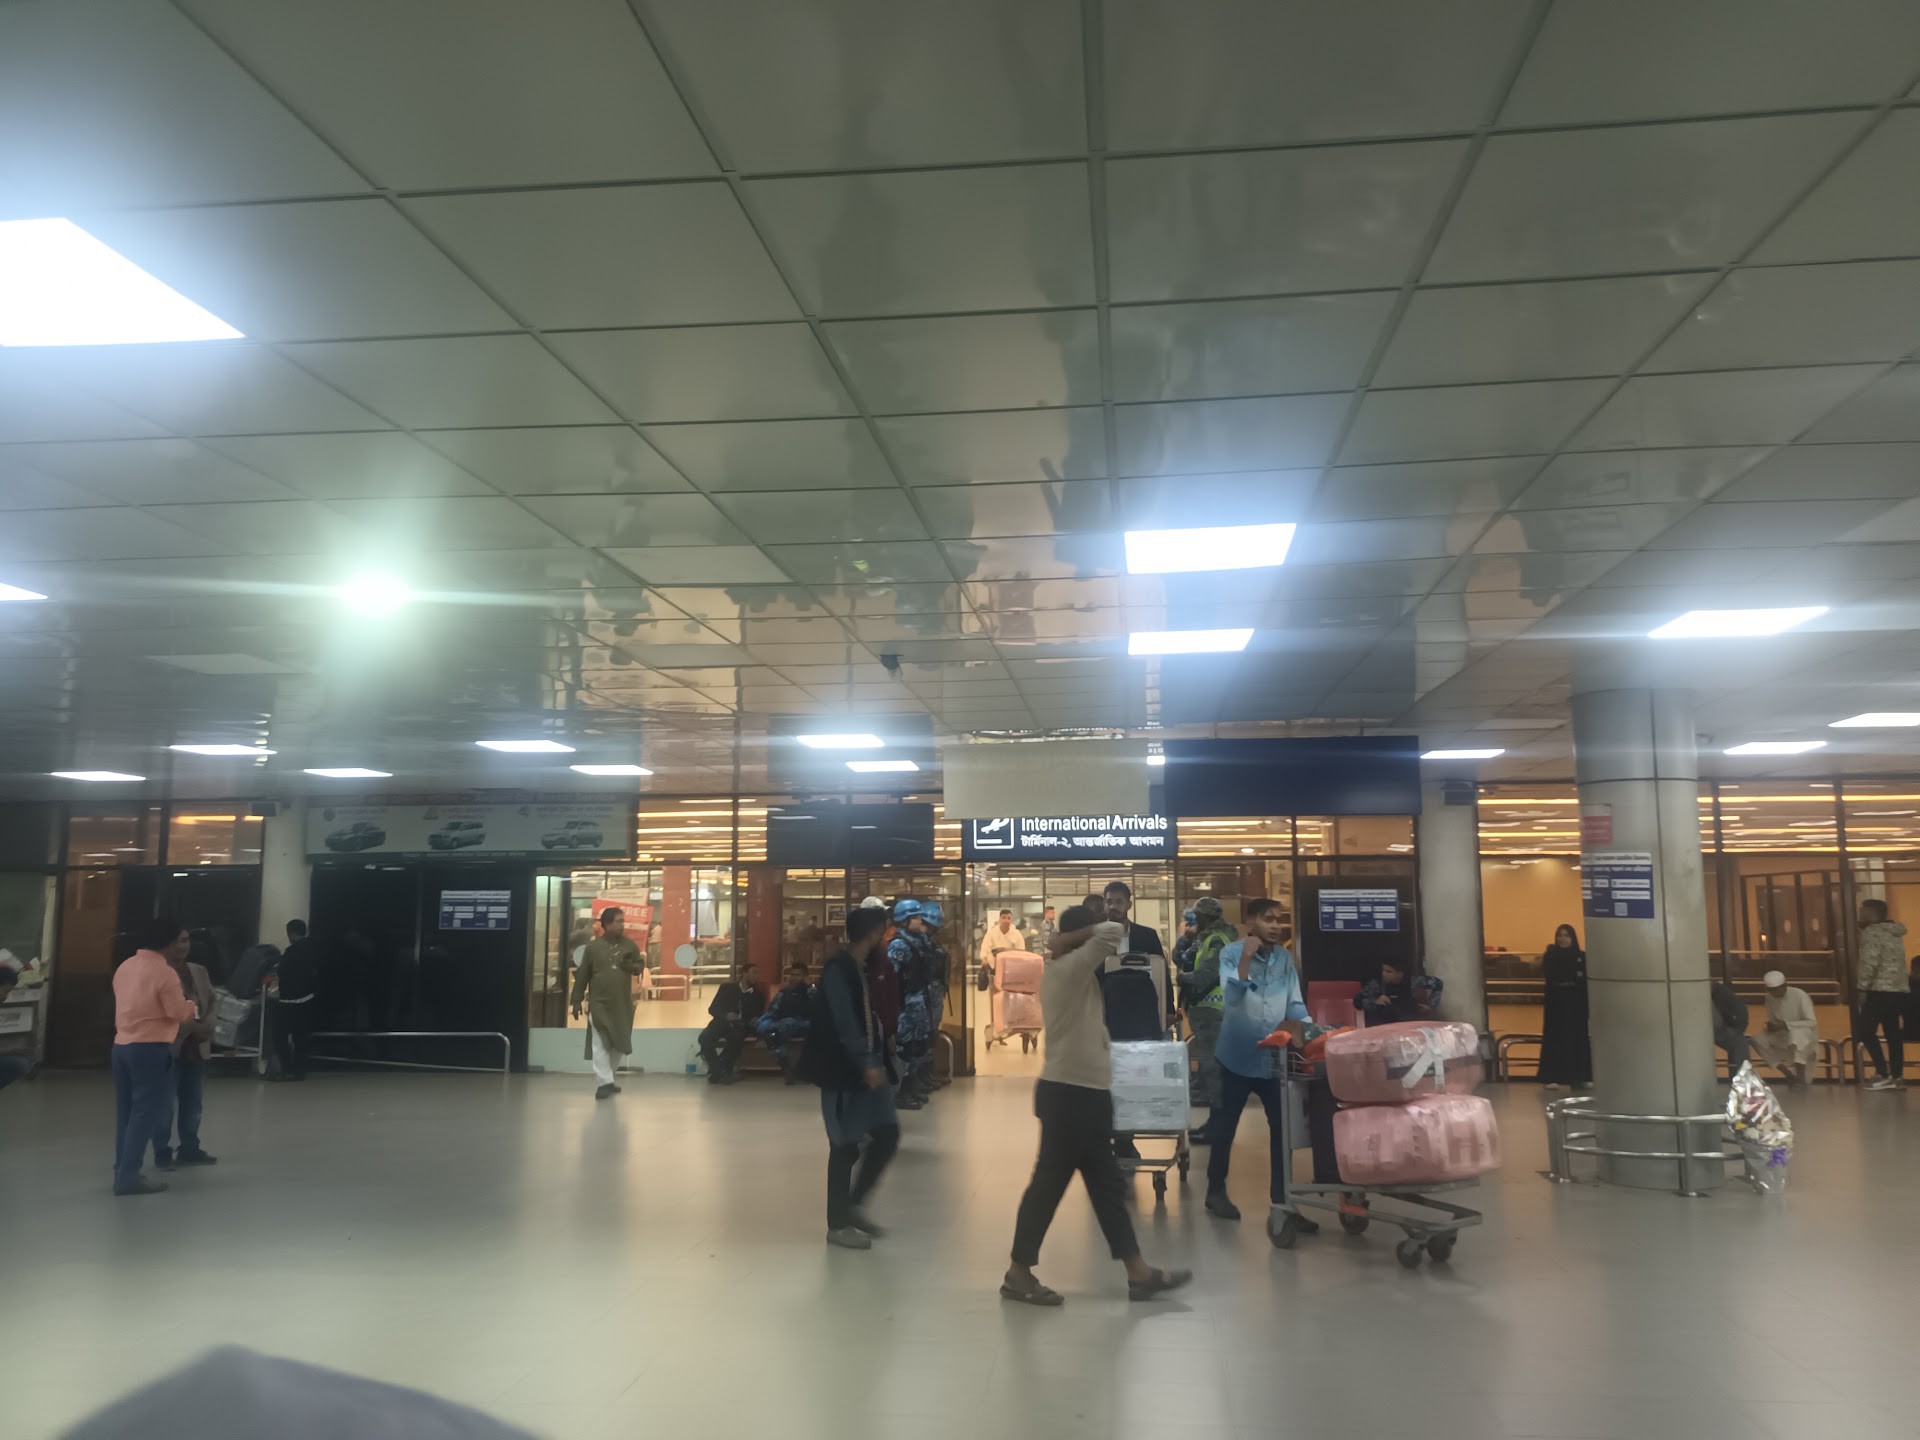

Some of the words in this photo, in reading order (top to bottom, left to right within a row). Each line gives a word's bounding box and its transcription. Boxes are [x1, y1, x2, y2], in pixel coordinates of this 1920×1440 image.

[1021, 815, 1110, 831] International
[1112, 814, 1168, 830] Arrivals
[1129, 835, 1165, 847] আগমন
